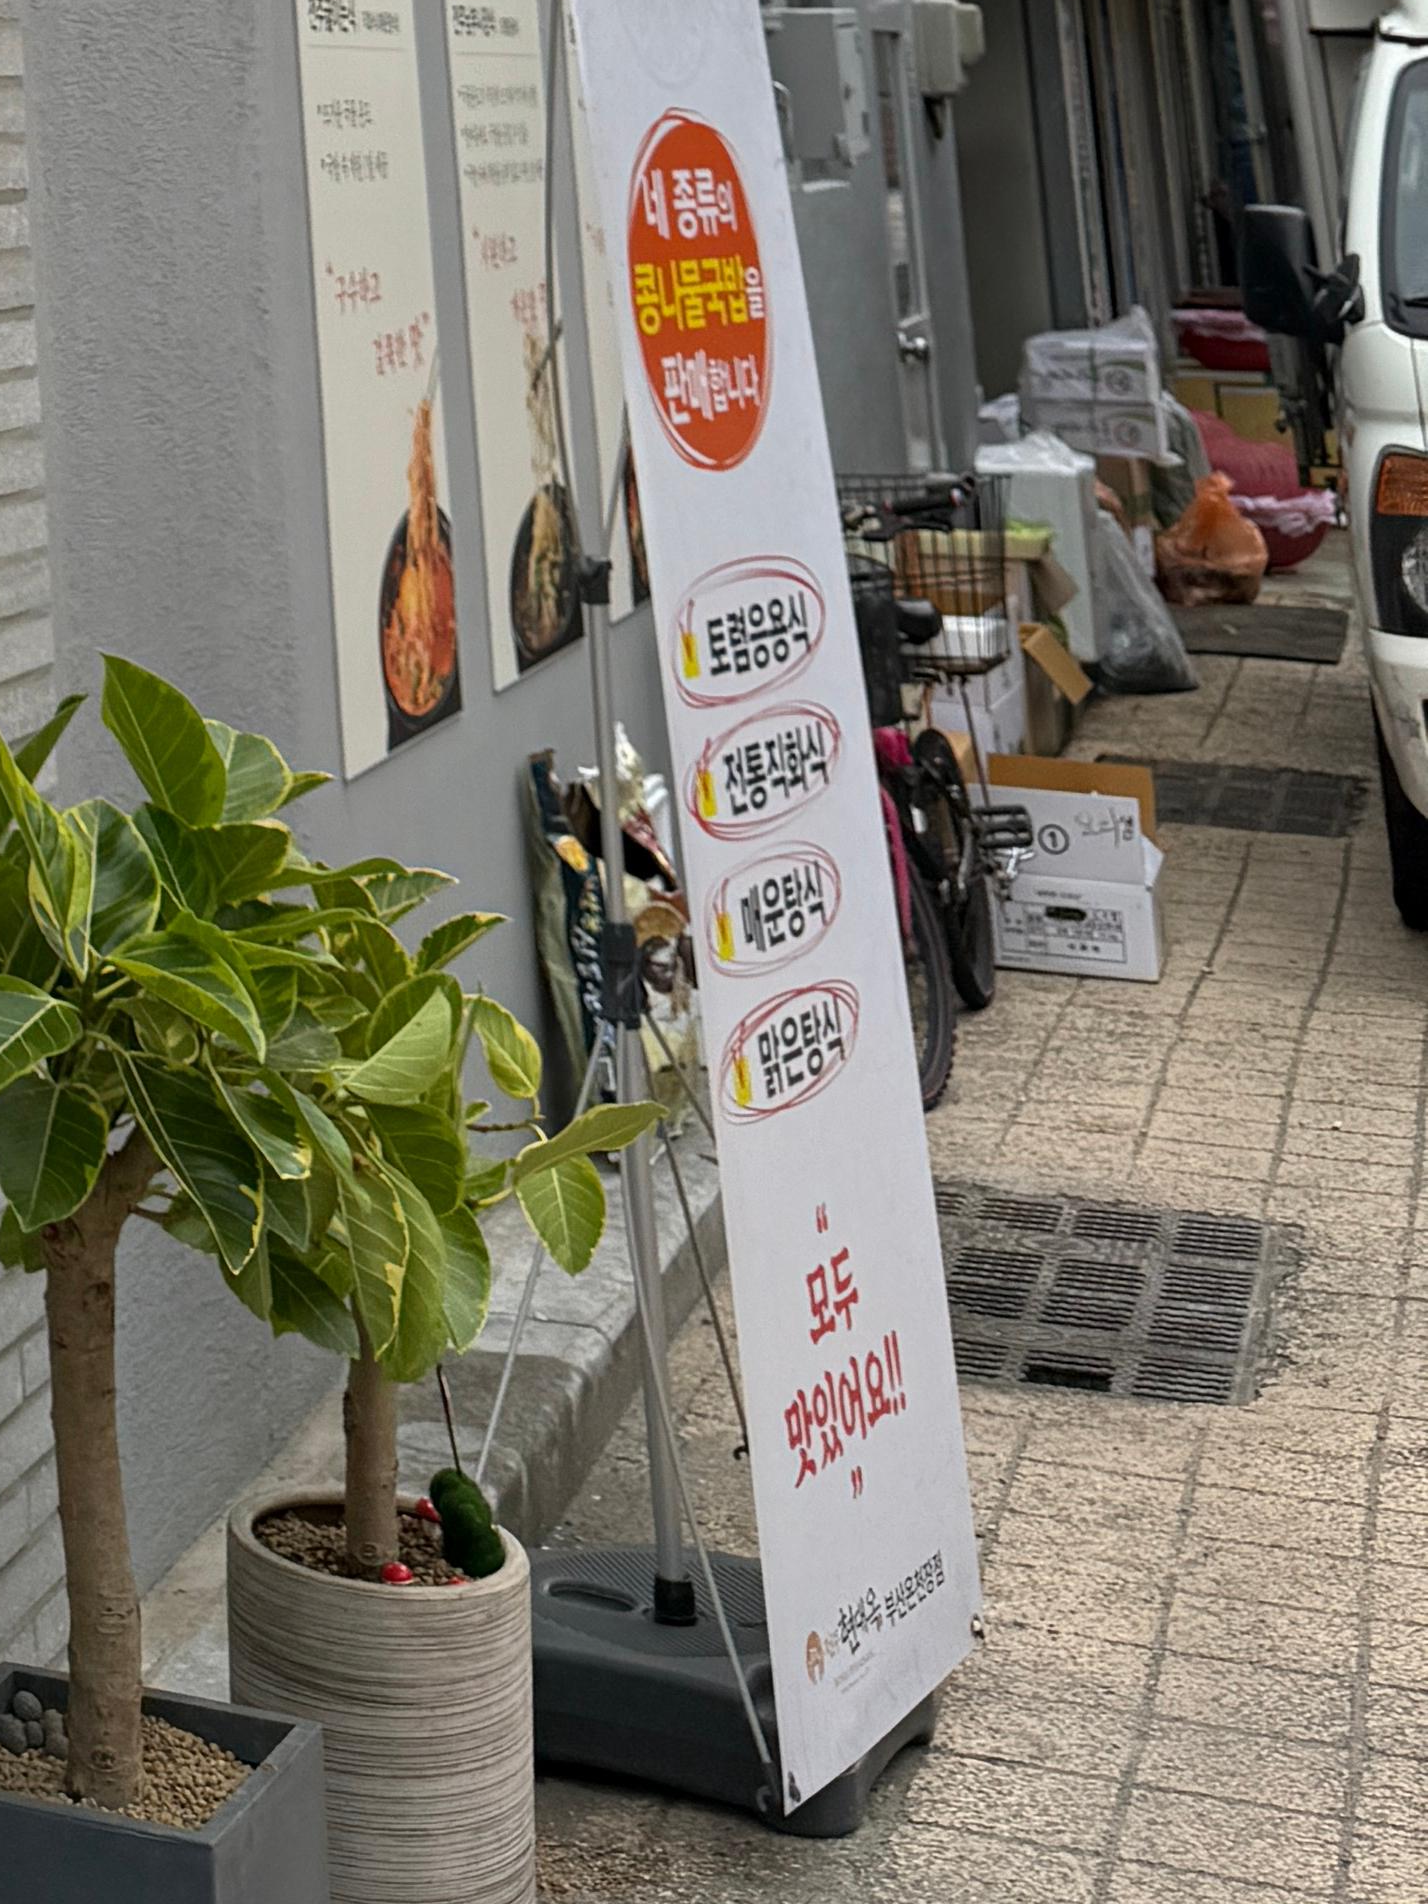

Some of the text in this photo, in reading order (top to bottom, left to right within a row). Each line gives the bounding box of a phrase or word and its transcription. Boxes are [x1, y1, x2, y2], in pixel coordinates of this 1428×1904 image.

[723, 720, 830, 816] 전통직화식
[740, 860, 829, 953] 매운탕식
[757, 993, 846, 1098] 맑은탕식
[804, 1246, 860, 1345] 모두
